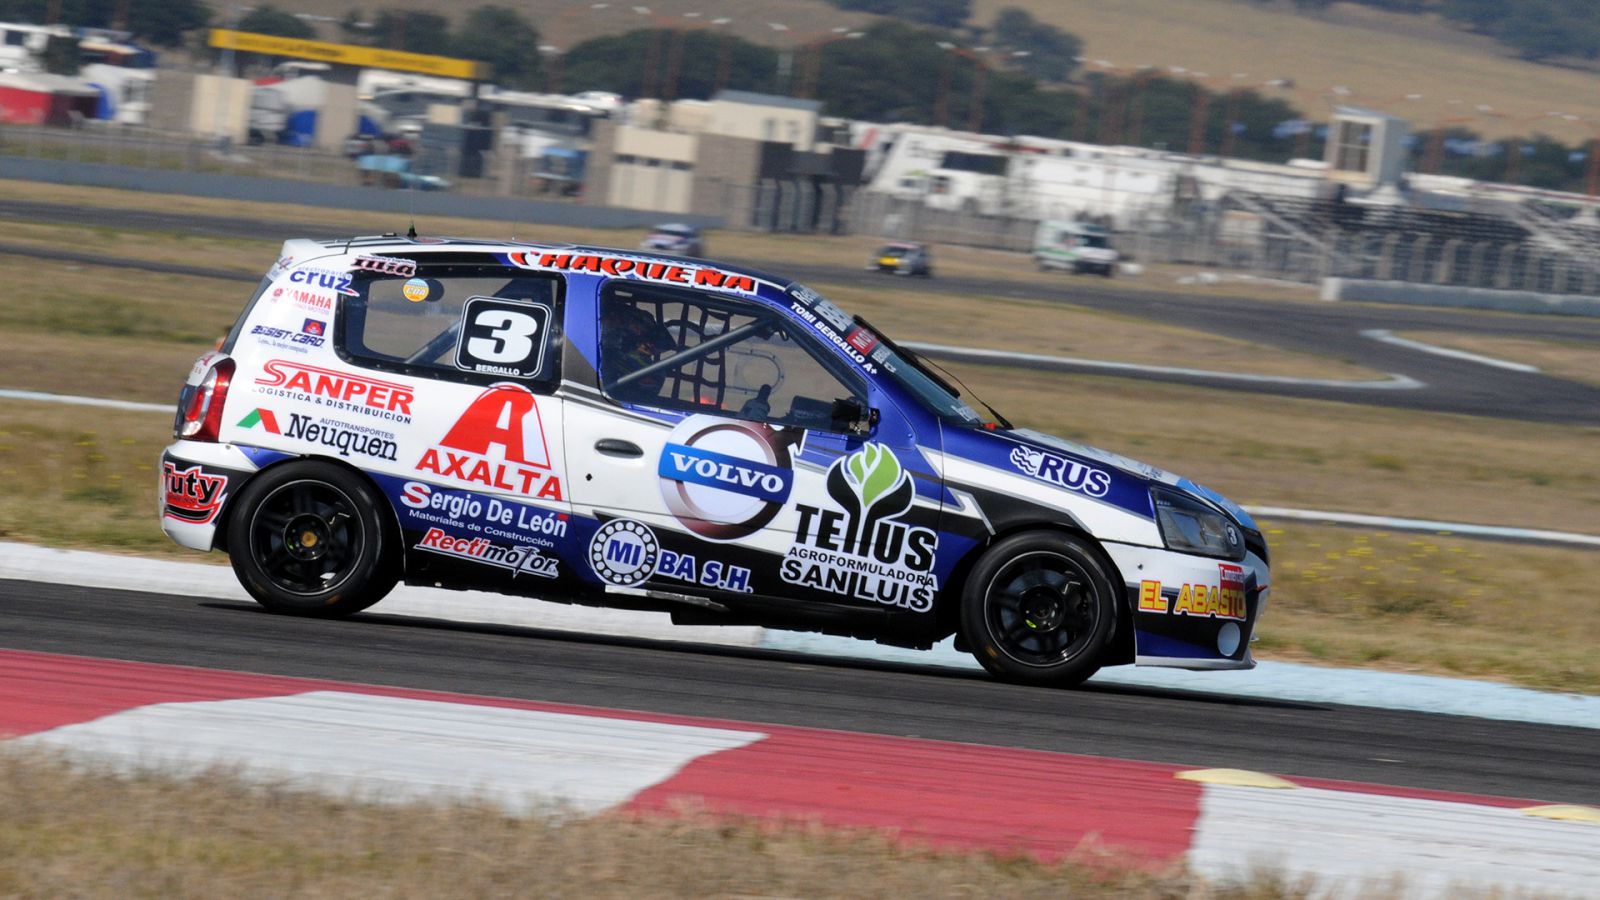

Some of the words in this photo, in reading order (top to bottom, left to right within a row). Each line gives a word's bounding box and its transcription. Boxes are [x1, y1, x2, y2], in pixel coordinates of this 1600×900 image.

[285, 287, 332, 310] YAMAHA
[289, 270, 351, 292] cruz
[467, 309, 538, 363] 3
[790, 301, 817, 323] TOMI
[814, 320, 866, 364] BERGALLO
[254, 359, 415, 416] SANPER
[475, 363, 520, 376] BERGALLO
[319, 417, 395, 440] AUTOTRANSPORTES
[326, 398, 412, 425] DISTRIBUICION
[284, 412, 398, 462] Neuquen
[415, 447, 563, 502] AXALTA
[669, 451, 784, 493] VOLVO
[1036, 453, 1110, 497] RUS
[400, 480, 482, 519] Sergio
[485, 499, 513, 525] De
[517, 506, 568, 538] León
[408, 508, 465, 529] Materiales
[467, 522, 482, 532] de
[484, 525, 554, 548] Construcción
[606, 539, 642, 567] MI
[657, 550, 695, 580] BA
[701, 561, 753, 593] S.H.
[782, 559, 848, 592] SAN
[855, 574, 933, 610] LUIS
[788, 545, 935, 588] AGROFORMULADORA
[1139, 579, 1167, 611] EL
[1174, 583, 1246, 619] ABASTO
